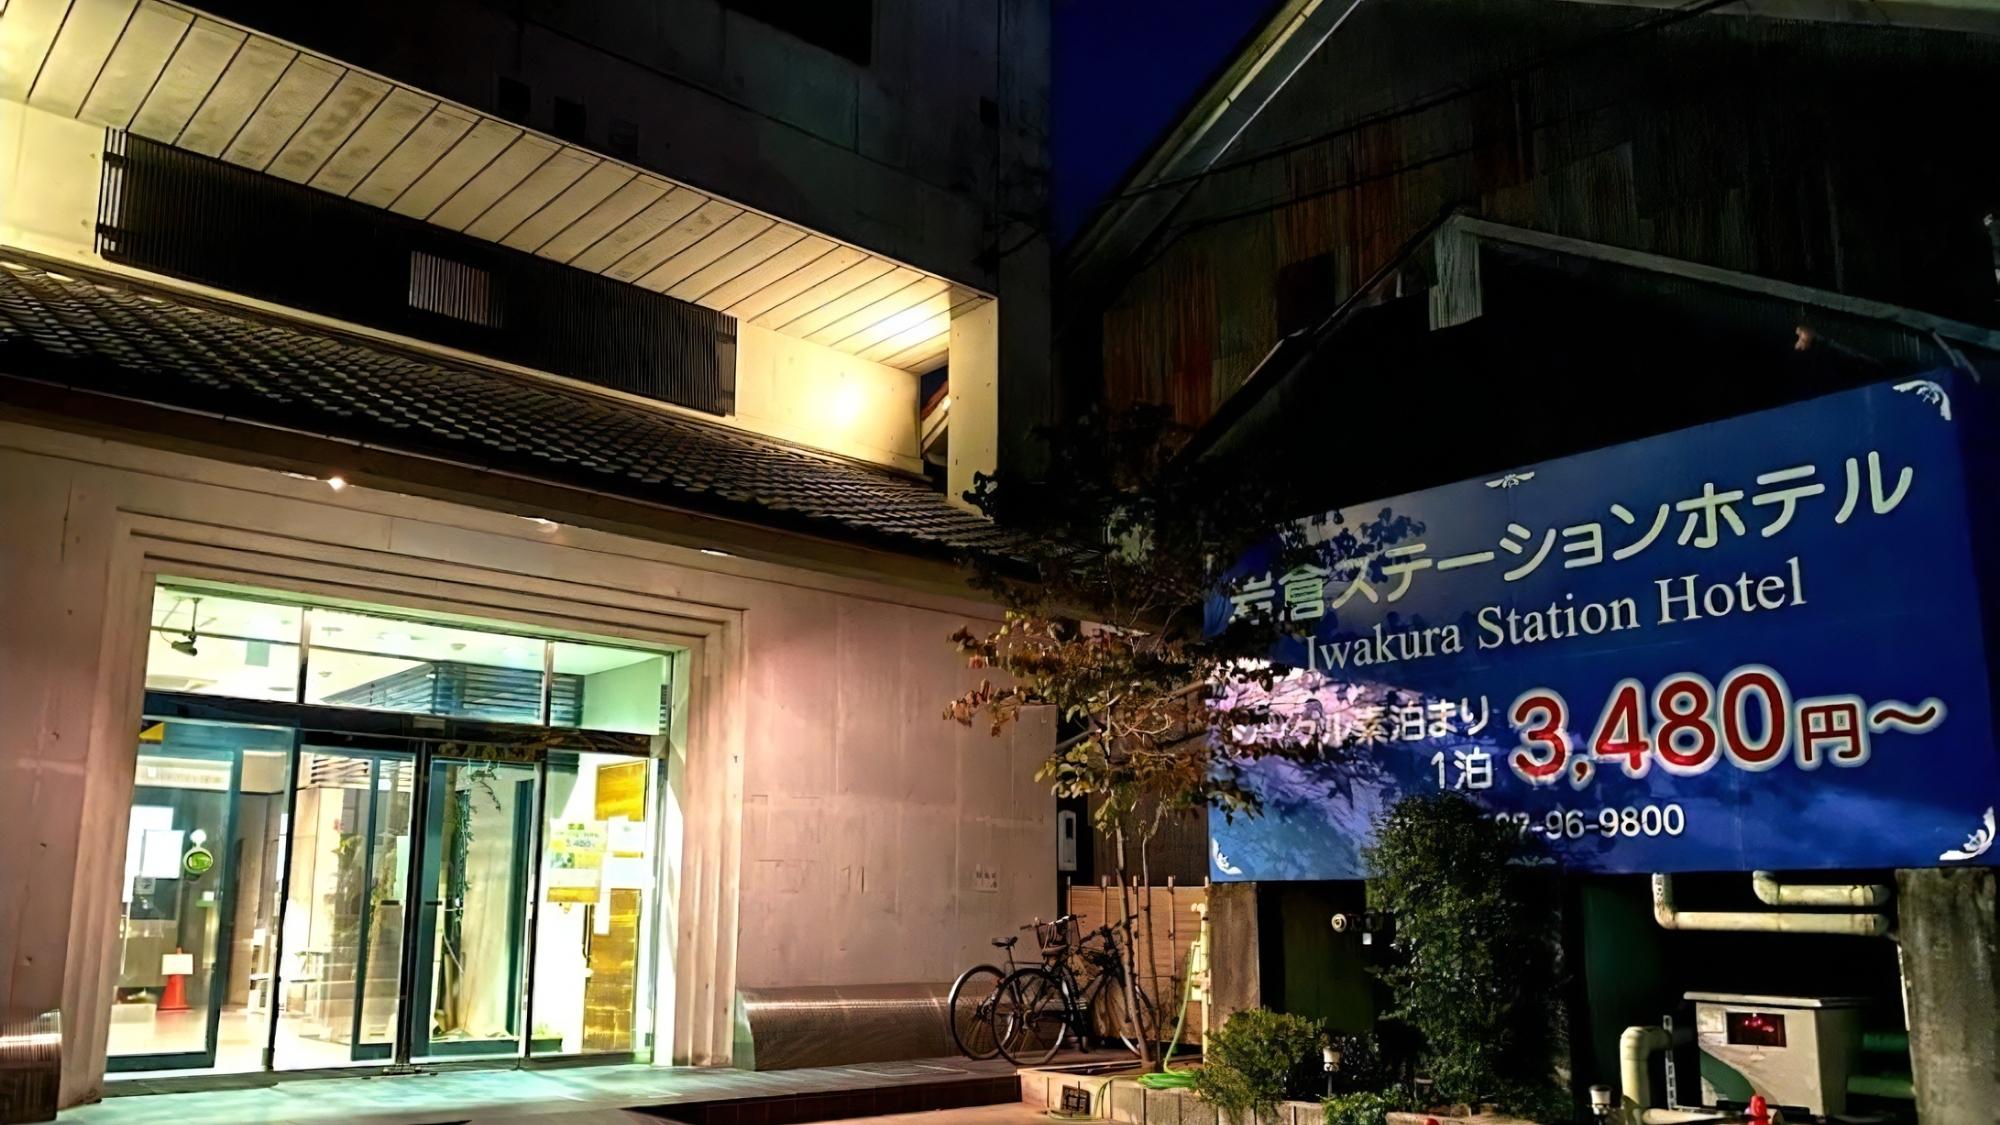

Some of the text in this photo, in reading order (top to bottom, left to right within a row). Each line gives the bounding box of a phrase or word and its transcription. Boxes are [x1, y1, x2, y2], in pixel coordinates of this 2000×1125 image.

[1305, 556, 1808, 672] Iwakura Station Hotel
[1430, 745, 1493, 790] 1泊
